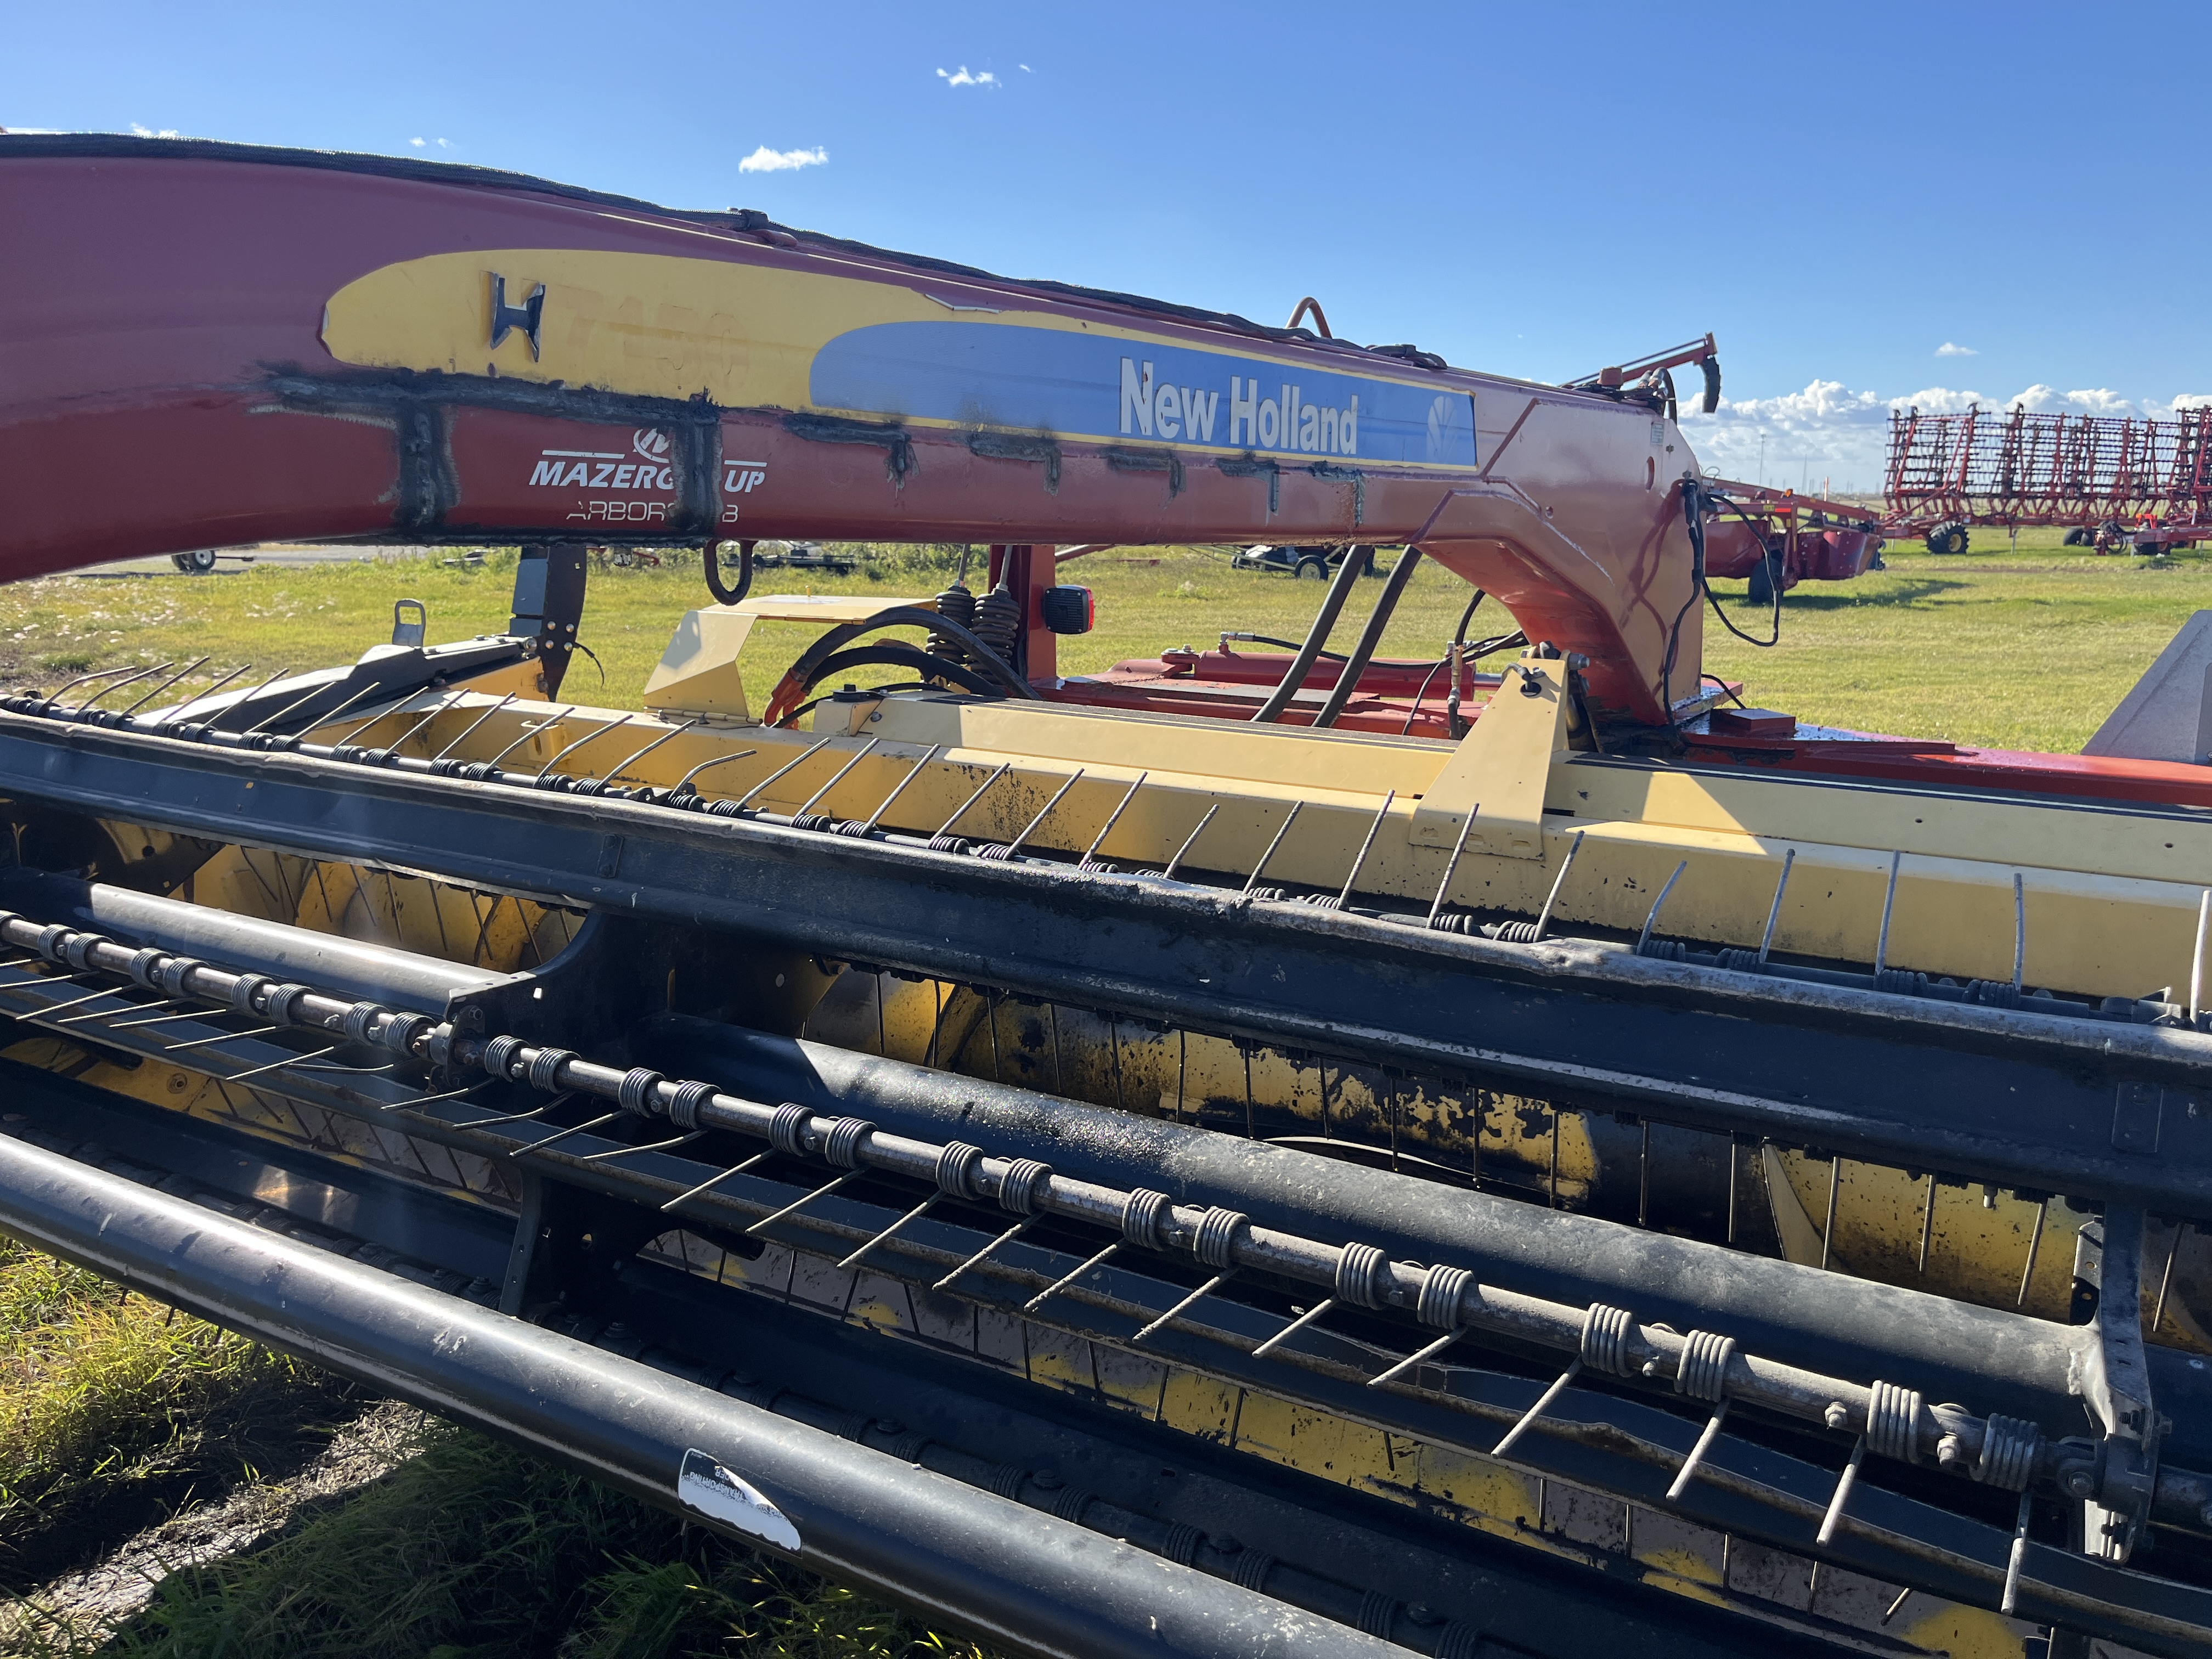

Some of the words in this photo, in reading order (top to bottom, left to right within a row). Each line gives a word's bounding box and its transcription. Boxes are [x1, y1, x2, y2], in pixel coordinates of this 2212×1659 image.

[1120, 357, 1218, 442] New
[1230, 376, 1358, 455] Holland
[566, 501, 676, 521] ARBOR
